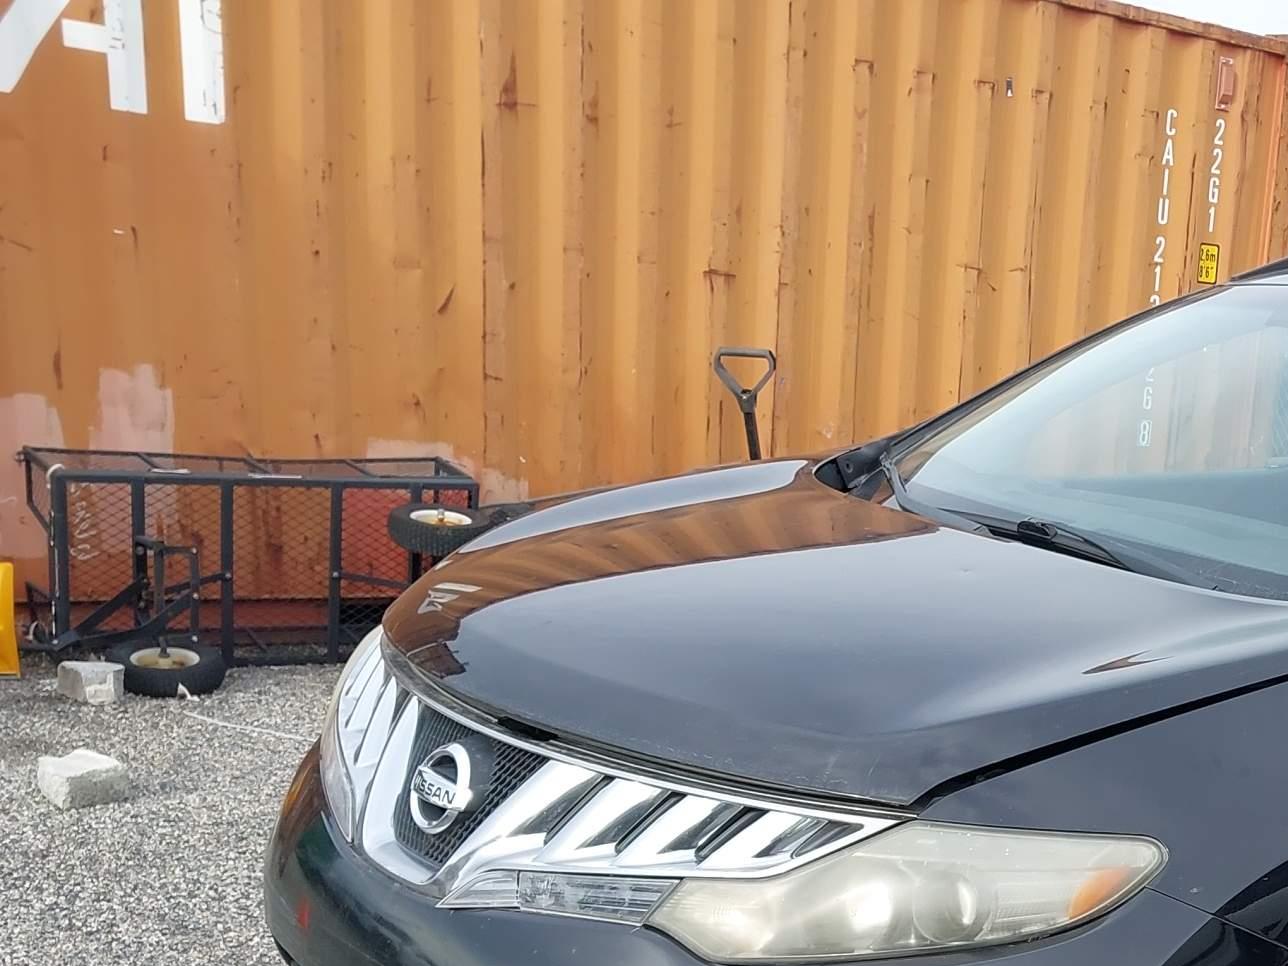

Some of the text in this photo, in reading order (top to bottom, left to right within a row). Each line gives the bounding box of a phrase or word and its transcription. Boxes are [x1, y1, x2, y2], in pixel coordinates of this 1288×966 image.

[1158, 109, 1177, 225] CAIU
[1208, 119, 1226, 232] 22G1
[414, 773, 456, 804] NISSAN
